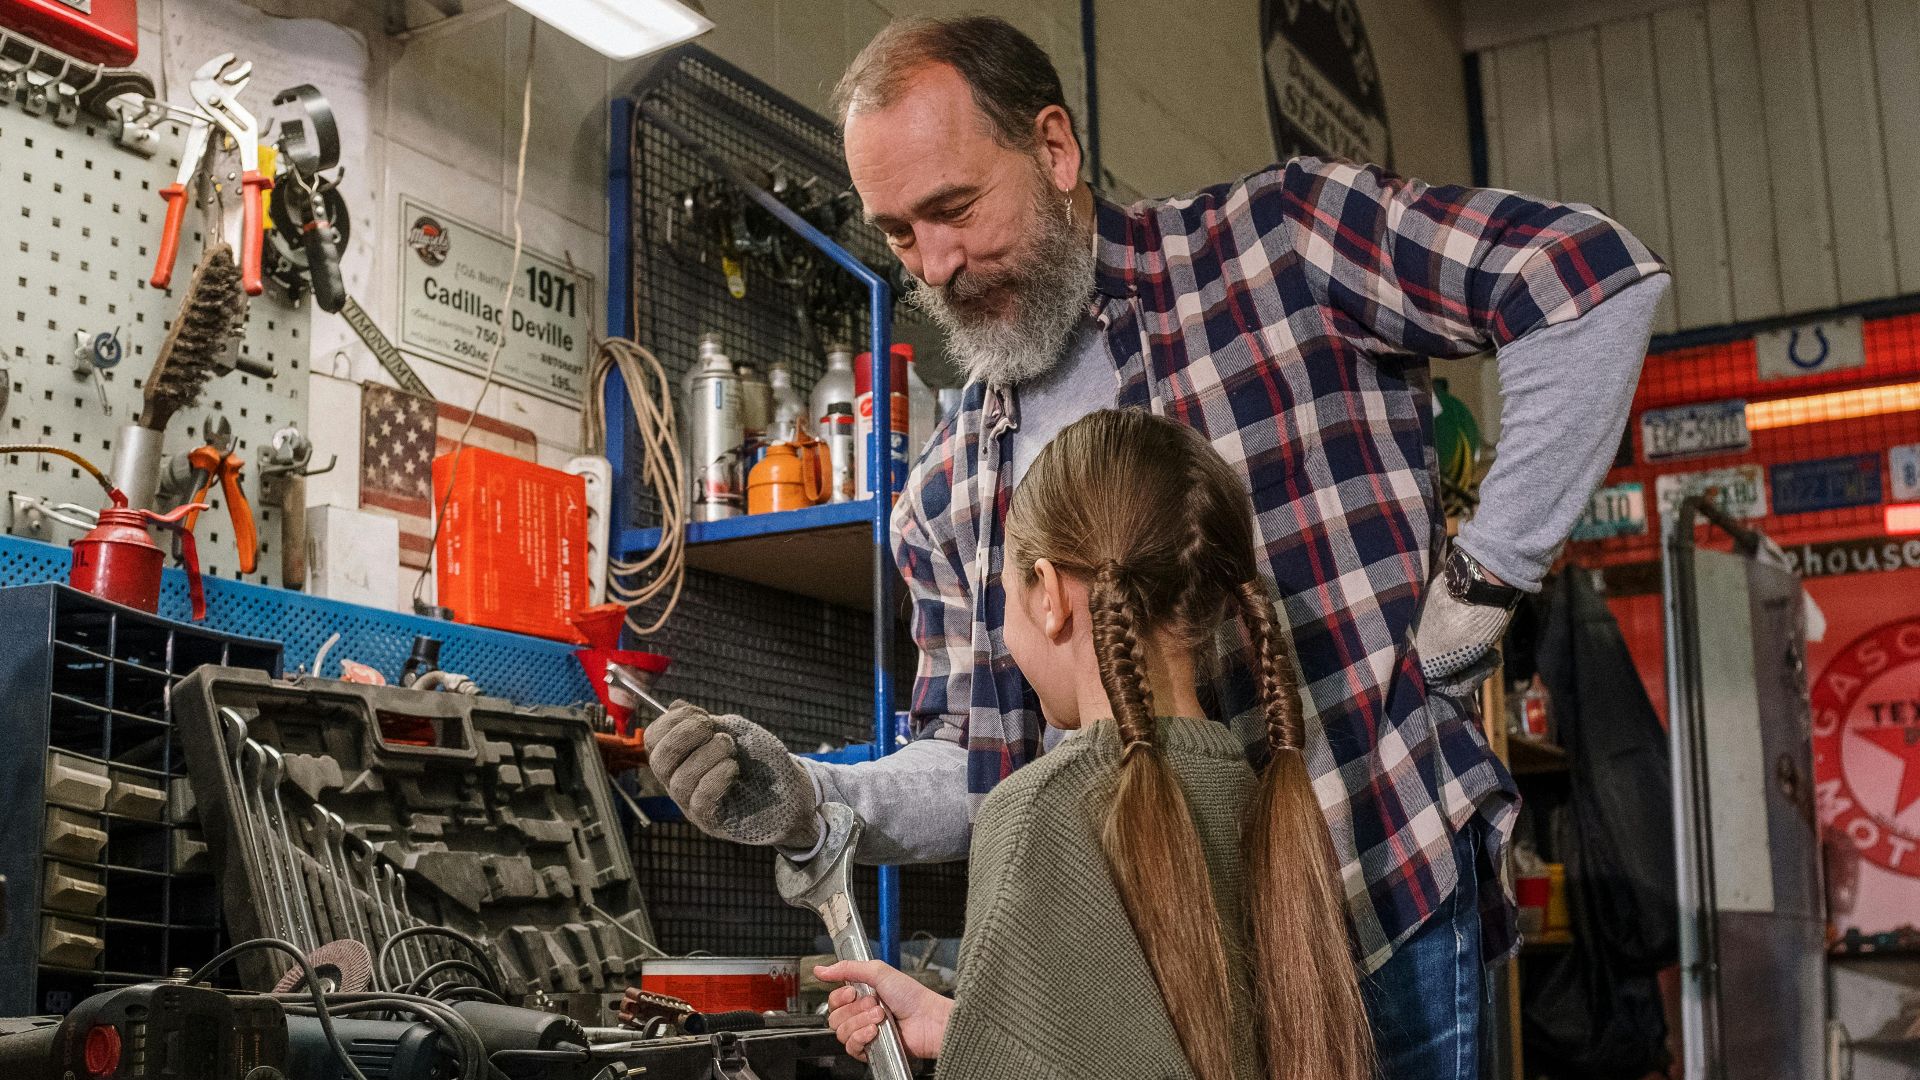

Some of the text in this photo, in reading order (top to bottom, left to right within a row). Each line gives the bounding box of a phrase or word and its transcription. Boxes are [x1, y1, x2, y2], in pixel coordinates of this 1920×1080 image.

[424, 277, 503, 326] Cadillac
[512, 310, 574, 352] Deville
[526, 265, 576, 318] 1971
